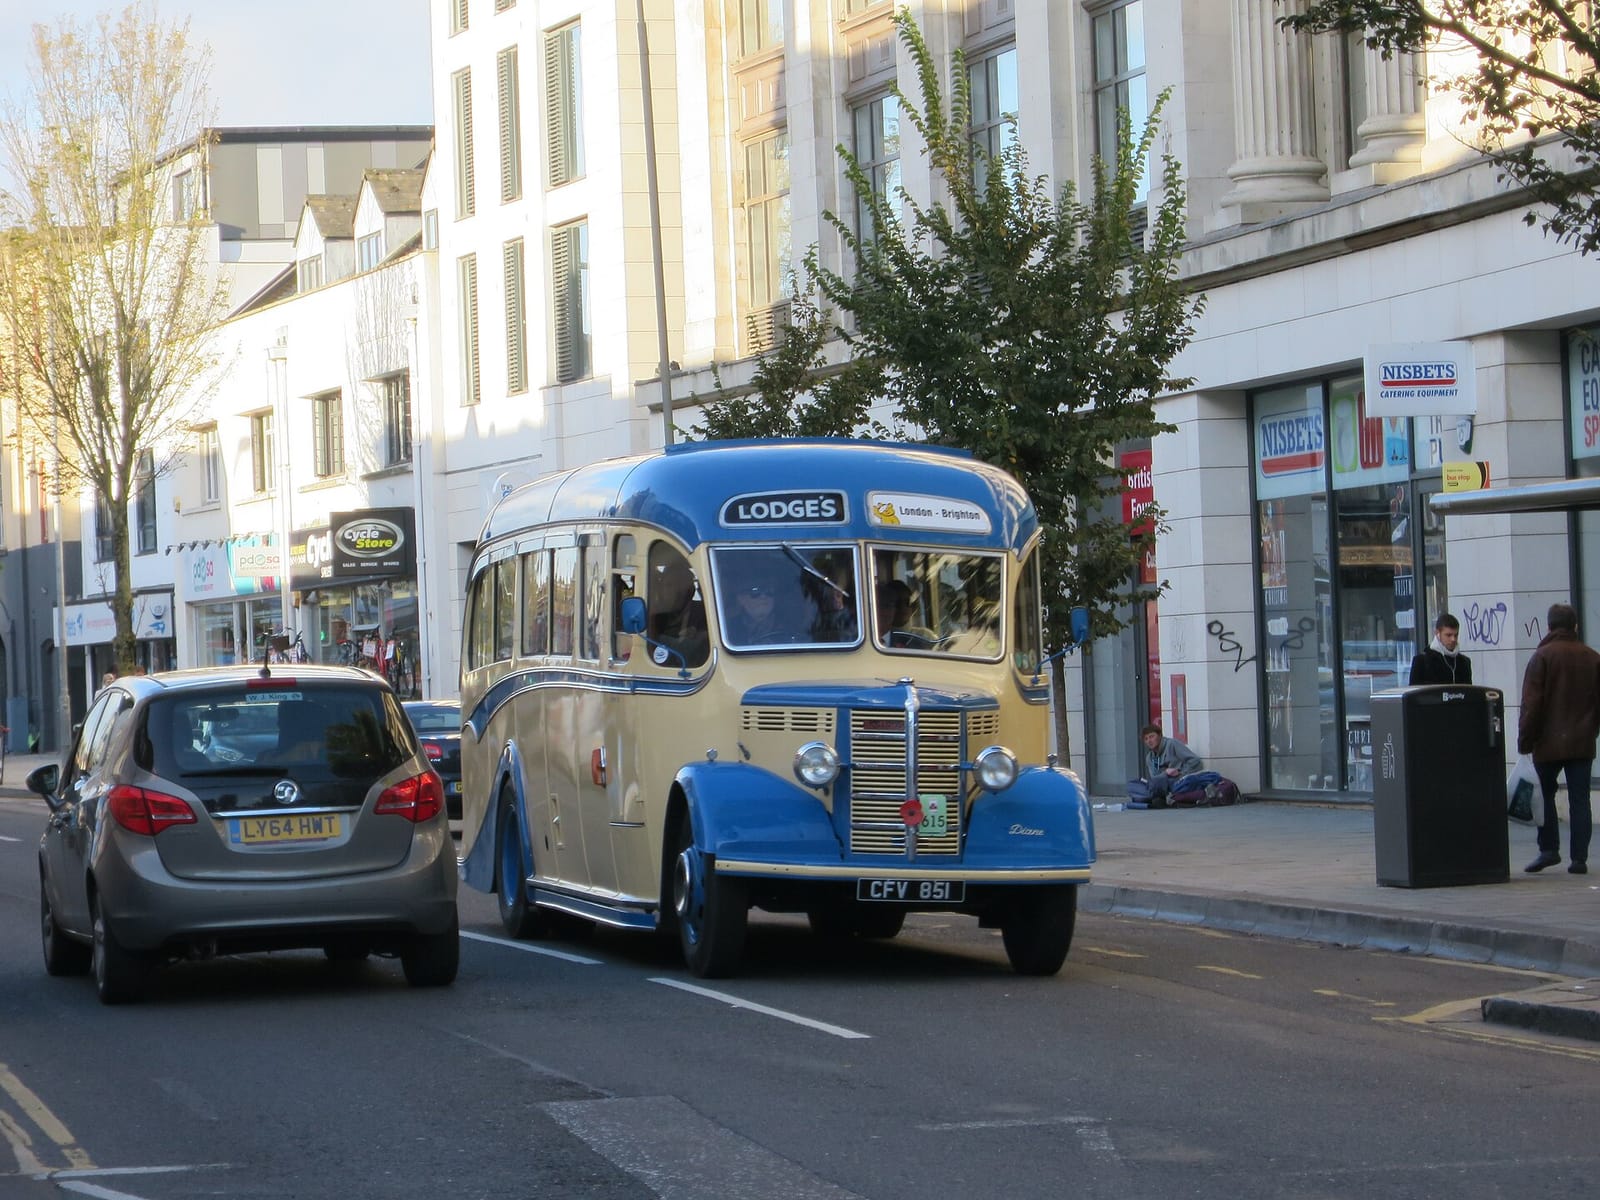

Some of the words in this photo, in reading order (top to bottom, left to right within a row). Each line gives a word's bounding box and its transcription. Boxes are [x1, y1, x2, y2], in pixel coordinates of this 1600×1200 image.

[1383, 363, 1455, 380] NISBETS
[1380, 390, 1415, 398] CATERING
[1417, 388, 1458, 397] EQUIPMENT
[1261, 414, 1323, 458] NISBETS
[738, 495, 837, 520] LODGE'S
[899, 505, 933, 517] London
[941, 509, 981, 521] Brighton
[344, 526, 380, 542] Cycle
[355, 539, 394, 549] Store
[243, 820, 293, 838] LY64
[299, 815, 334, 834] HWT
[922, 815, 945, 828] 615
[1009, 824, 1045, 836] Diane
[870, 881, 908, 898] CFV
[919, 881, 950, 899] 851
